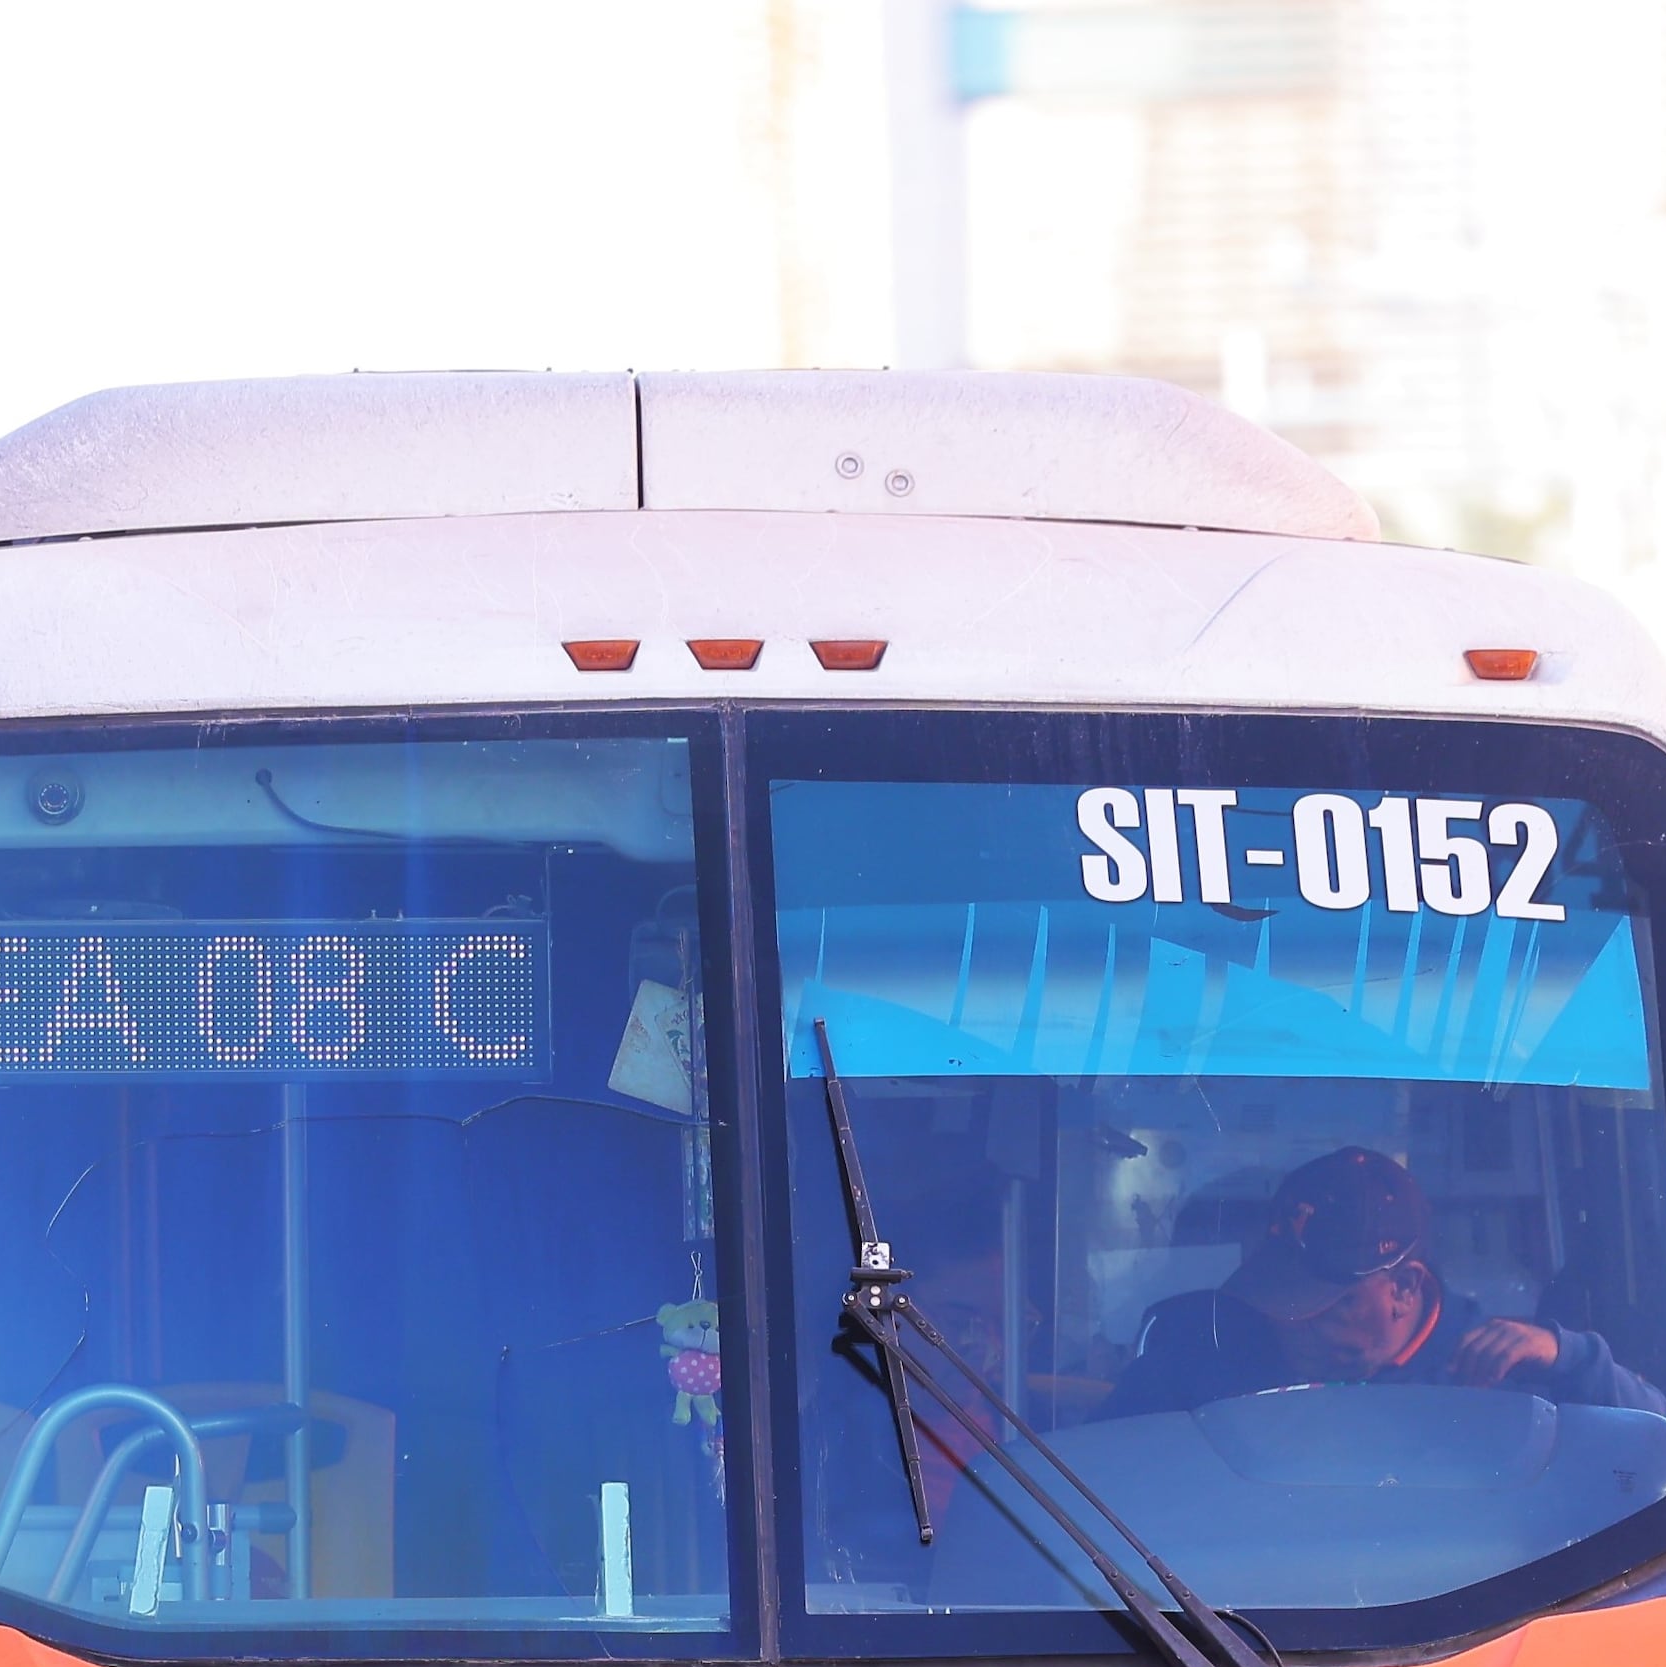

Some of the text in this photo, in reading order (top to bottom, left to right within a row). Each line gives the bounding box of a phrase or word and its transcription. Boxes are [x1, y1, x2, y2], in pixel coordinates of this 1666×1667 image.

[1076, 787, 1567, 922] SIT-0152
[198, 935, 366, 1062] 08
[434, 935, 527, 1061] C
